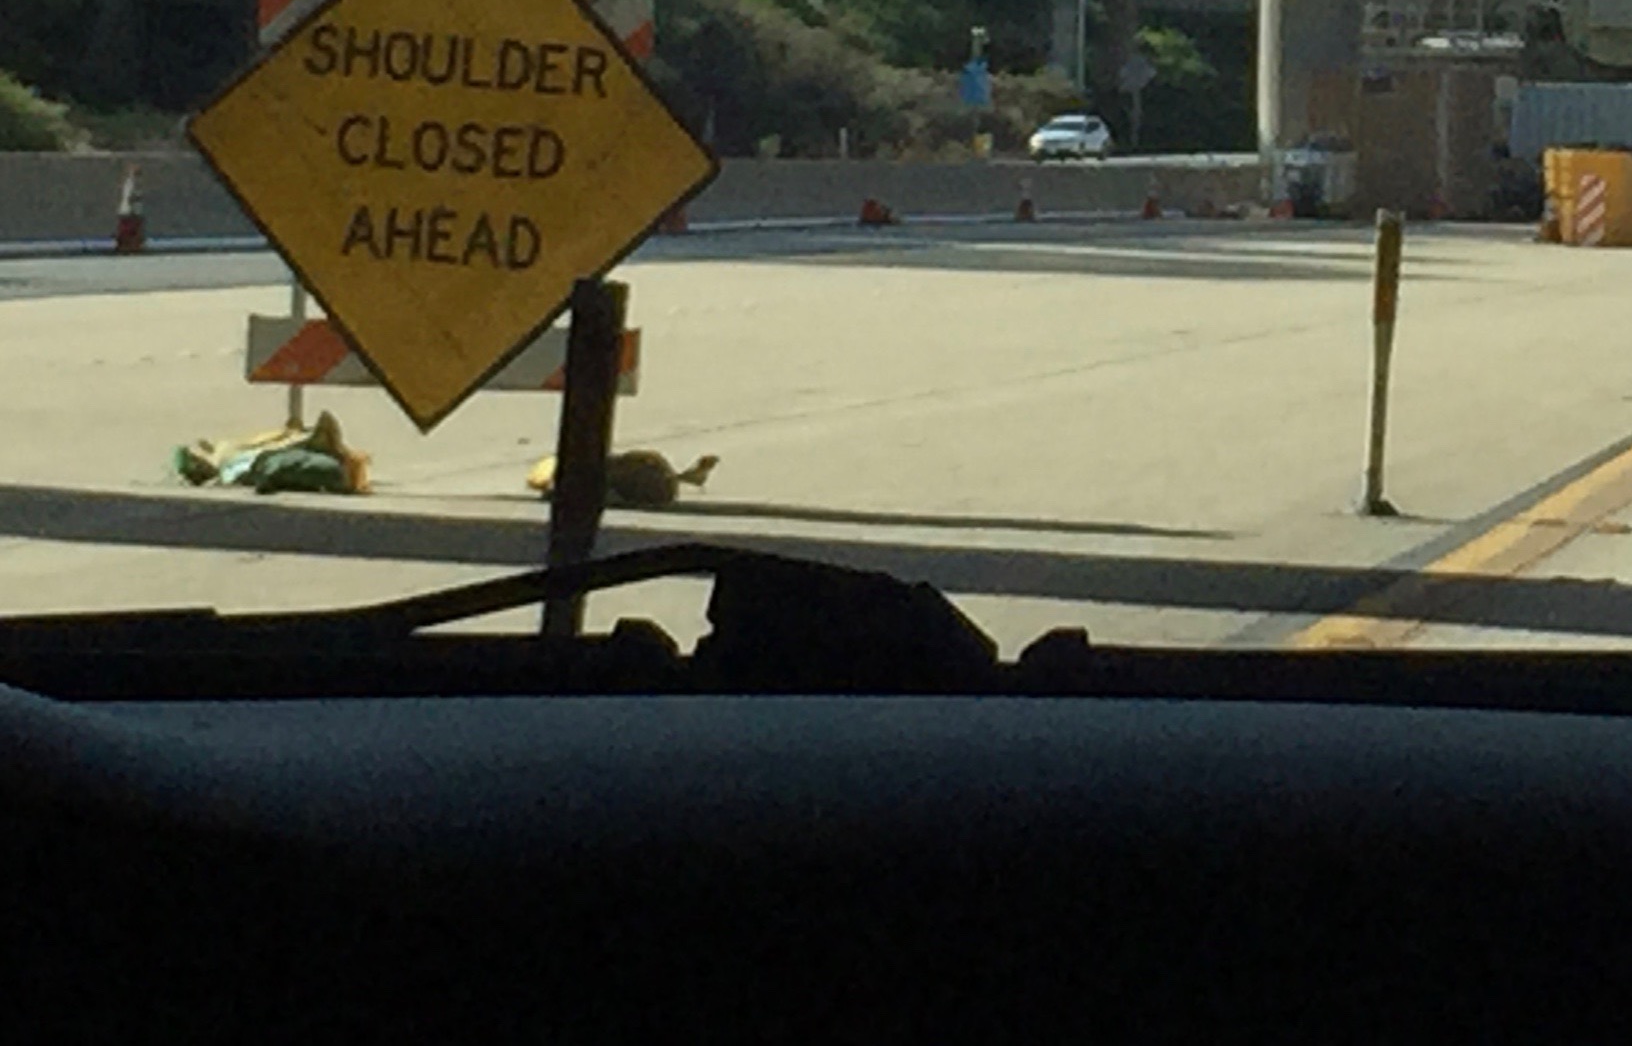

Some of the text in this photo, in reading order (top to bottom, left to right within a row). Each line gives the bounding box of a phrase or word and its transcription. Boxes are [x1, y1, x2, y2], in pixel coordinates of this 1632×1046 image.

[303, 23, 607, 98] SHOULDER
[337, 114, 565, 179] CLOSED
[341, 205, 542, 270] AHEAD
